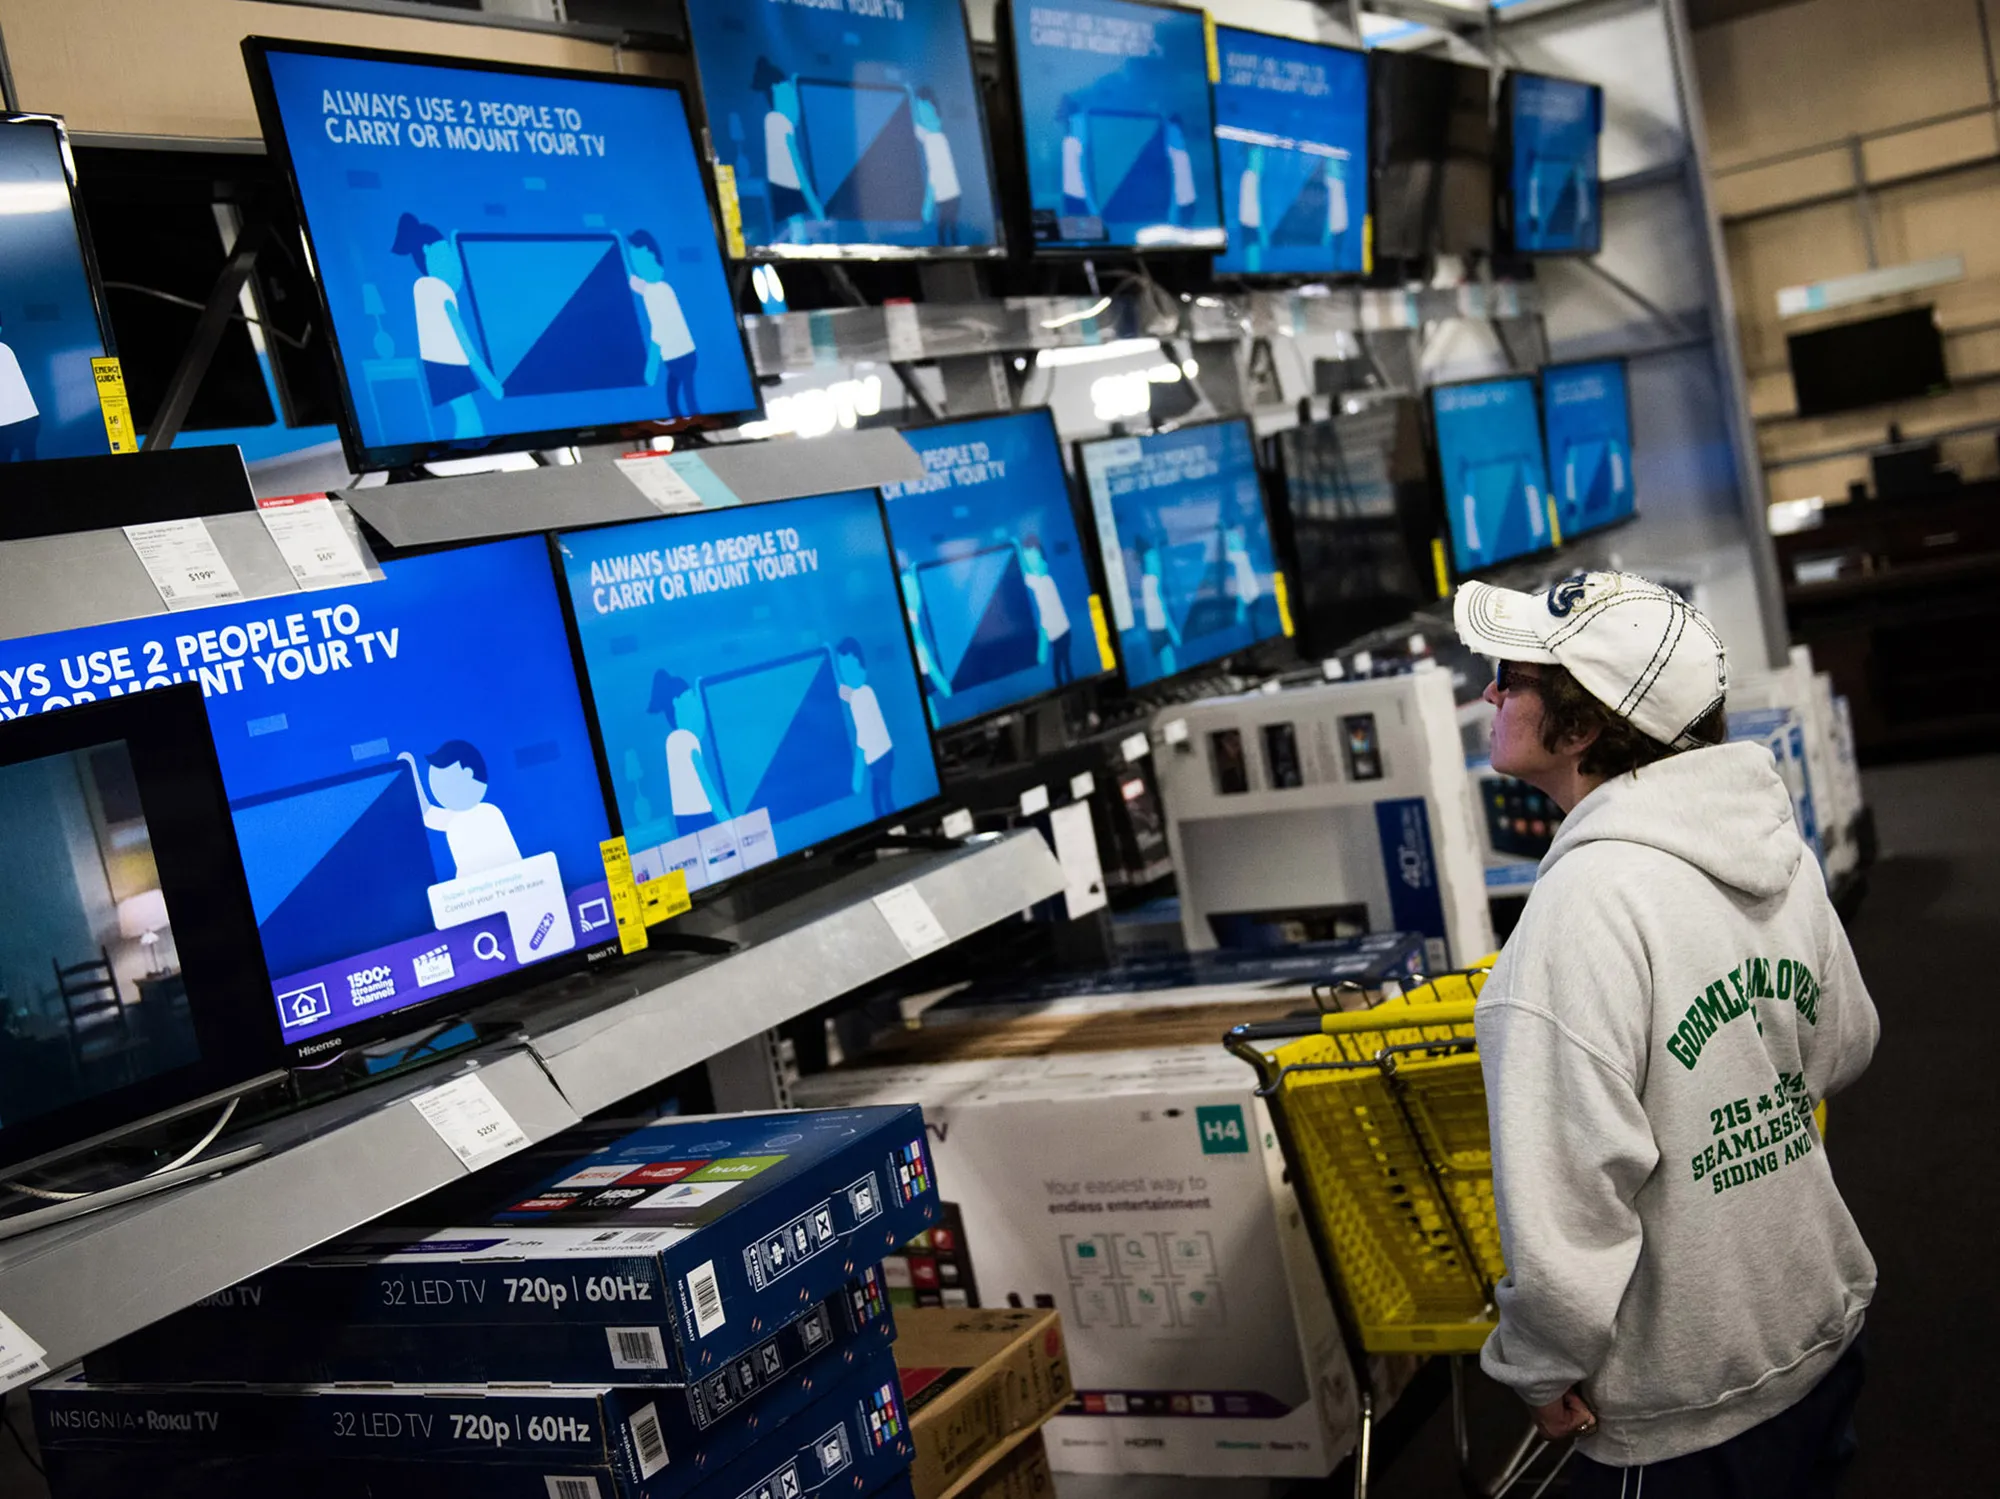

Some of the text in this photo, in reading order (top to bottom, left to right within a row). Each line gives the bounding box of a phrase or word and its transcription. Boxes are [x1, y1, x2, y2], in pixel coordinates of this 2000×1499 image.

[322, 89, 582, 131] ALWAYS USE 2 PEOPLE TO
[325, 118, 605, 157] CARRY OR MOUNT YOUR TV
[591, 527, 799, 586] ALWAYS USE 2 PEOPLE TO
[593, 548, 818, 614] CARRY OR MOUNT YOUR TV
[0, 603, 360, 701] YS USE 2 PEOPLE TO
[253, 640, 353, 685] YOUR
[355, 628, 399, 663] TV
[445, 900, 474, 913] Control
[476, 893, 494, 905] your
[495, 888, 506, 898] TV
[508, 884, 525, 894] with
[346, 965, 391, 989] 1500+
[351, 978, 394, 998] Streaming
[352, 987, 396, 1006] Channels
[298, 1037, 342, 1058] Hisense
[1204, 1119, 1241, 1141] H4
[1710, 1098, 1752, 1136] 215
[708, 1165, 758, 1174] hulu
[1712, 1132, 1812, 1194] SIDING AND
[1044, 1180, 1080, 1195] Your
[1188, 1175, 1207, 1190] to
[236, 1286, 261, 1306] TV
[382, 1279, 405, 1306] 32
[411, 1279, 454, 1305] LED
[455, 1279, 486, 1304] TV
[503, 1277, 567, 1309] 720p
[586, 1276, 652, 1302] 60Hz
[50, 1410, 219, 1431] INSIGNIA Roku TV
[333, 1412, 356, 1437] 32
[362, 1412, 402, 1438] LED
[405, 1413, 433, 1438] TV
[450, 1414, 510, 1447] 720p
[528, 1415, 591, 1442] 60Hz
